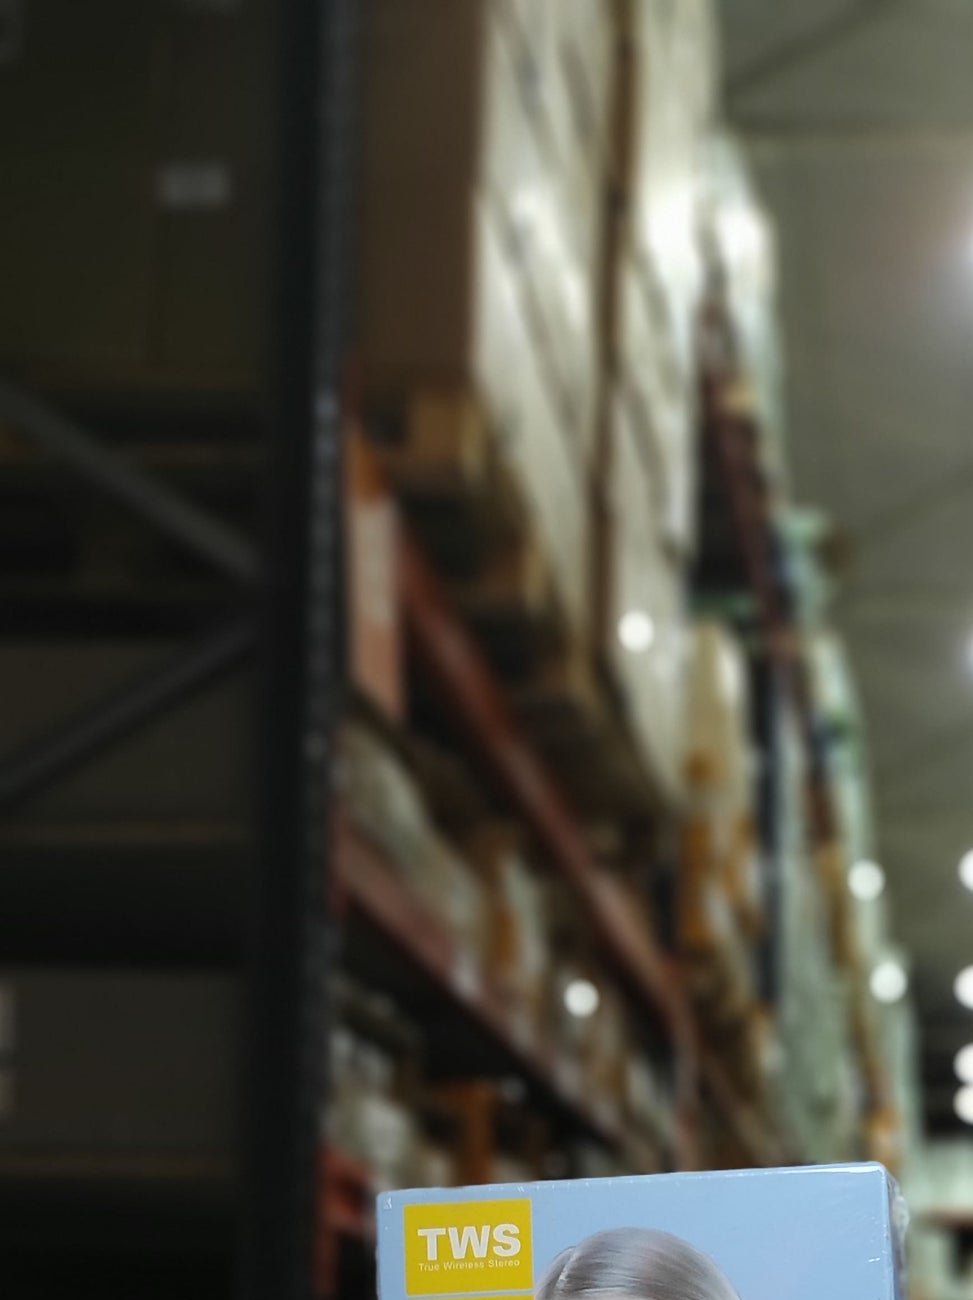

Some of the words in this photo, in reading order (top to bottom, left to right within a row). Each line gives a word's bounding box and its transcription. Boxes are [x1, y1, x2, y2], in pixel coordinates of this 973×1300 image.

[417, 1223, 521, 1261] TWS
[419, 1263, 439, 1271] True
[444, 1261, 484, 1270] Wireless
[489, 1259, 519, 1267] Stereo
